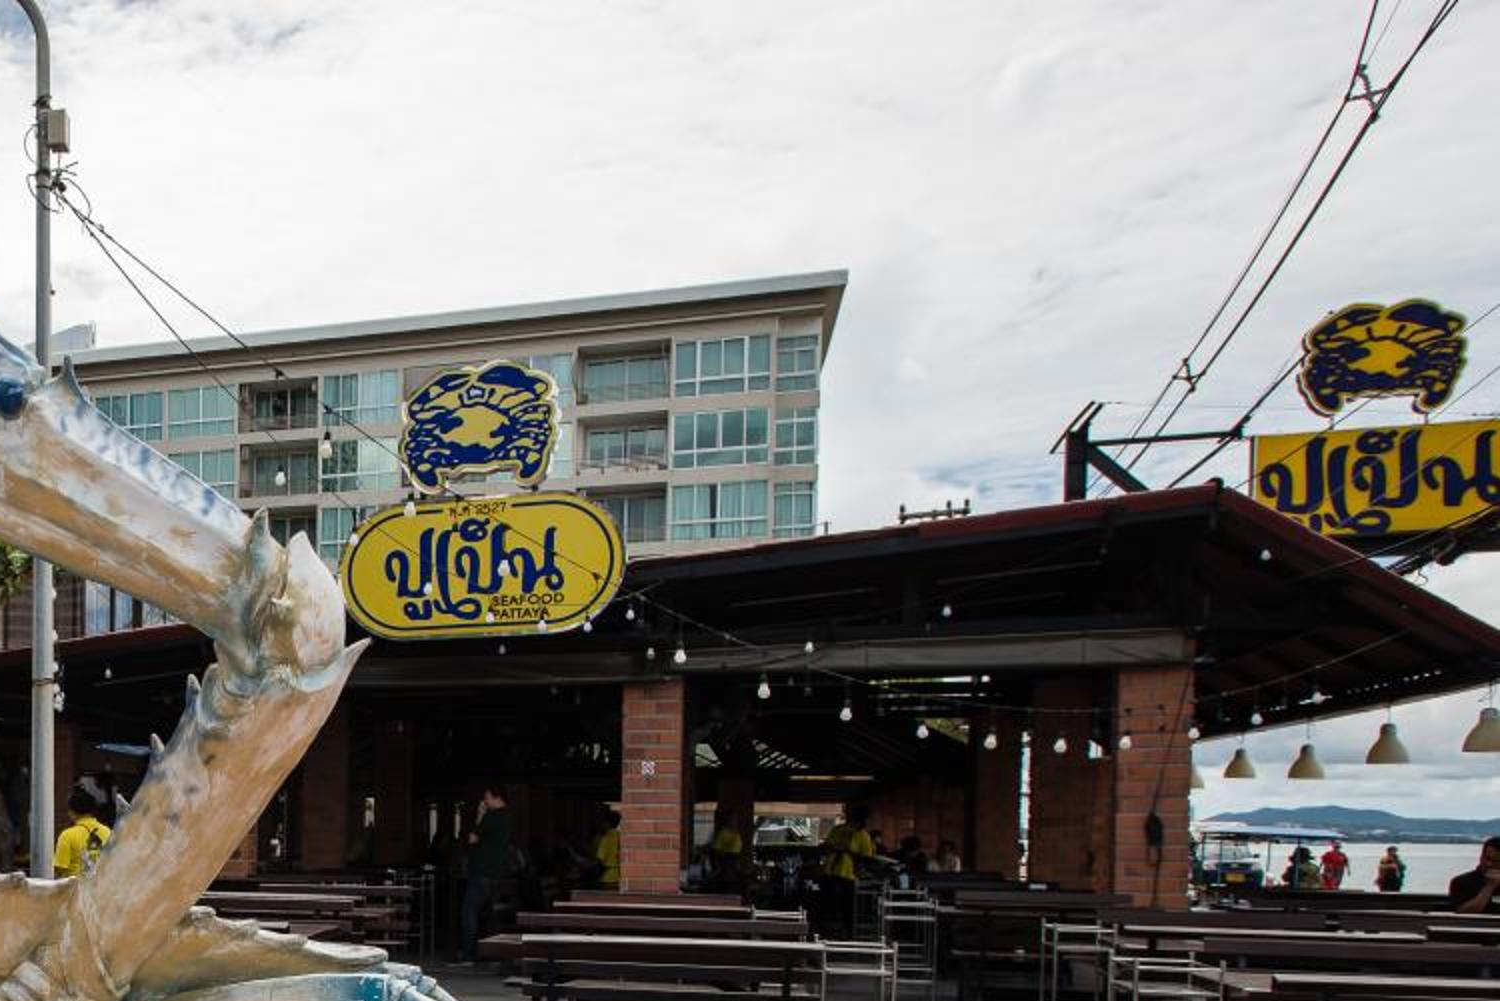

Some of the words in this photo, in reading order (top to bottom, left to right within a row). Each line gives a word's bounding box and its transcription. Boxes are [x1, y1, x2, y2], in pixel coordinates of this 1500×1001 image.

[385, 517, 565, 620] ปูเป็น
[492, 592, 564, 606] SEAFOOD
[493, 606, 550, 619] PATTAYA
